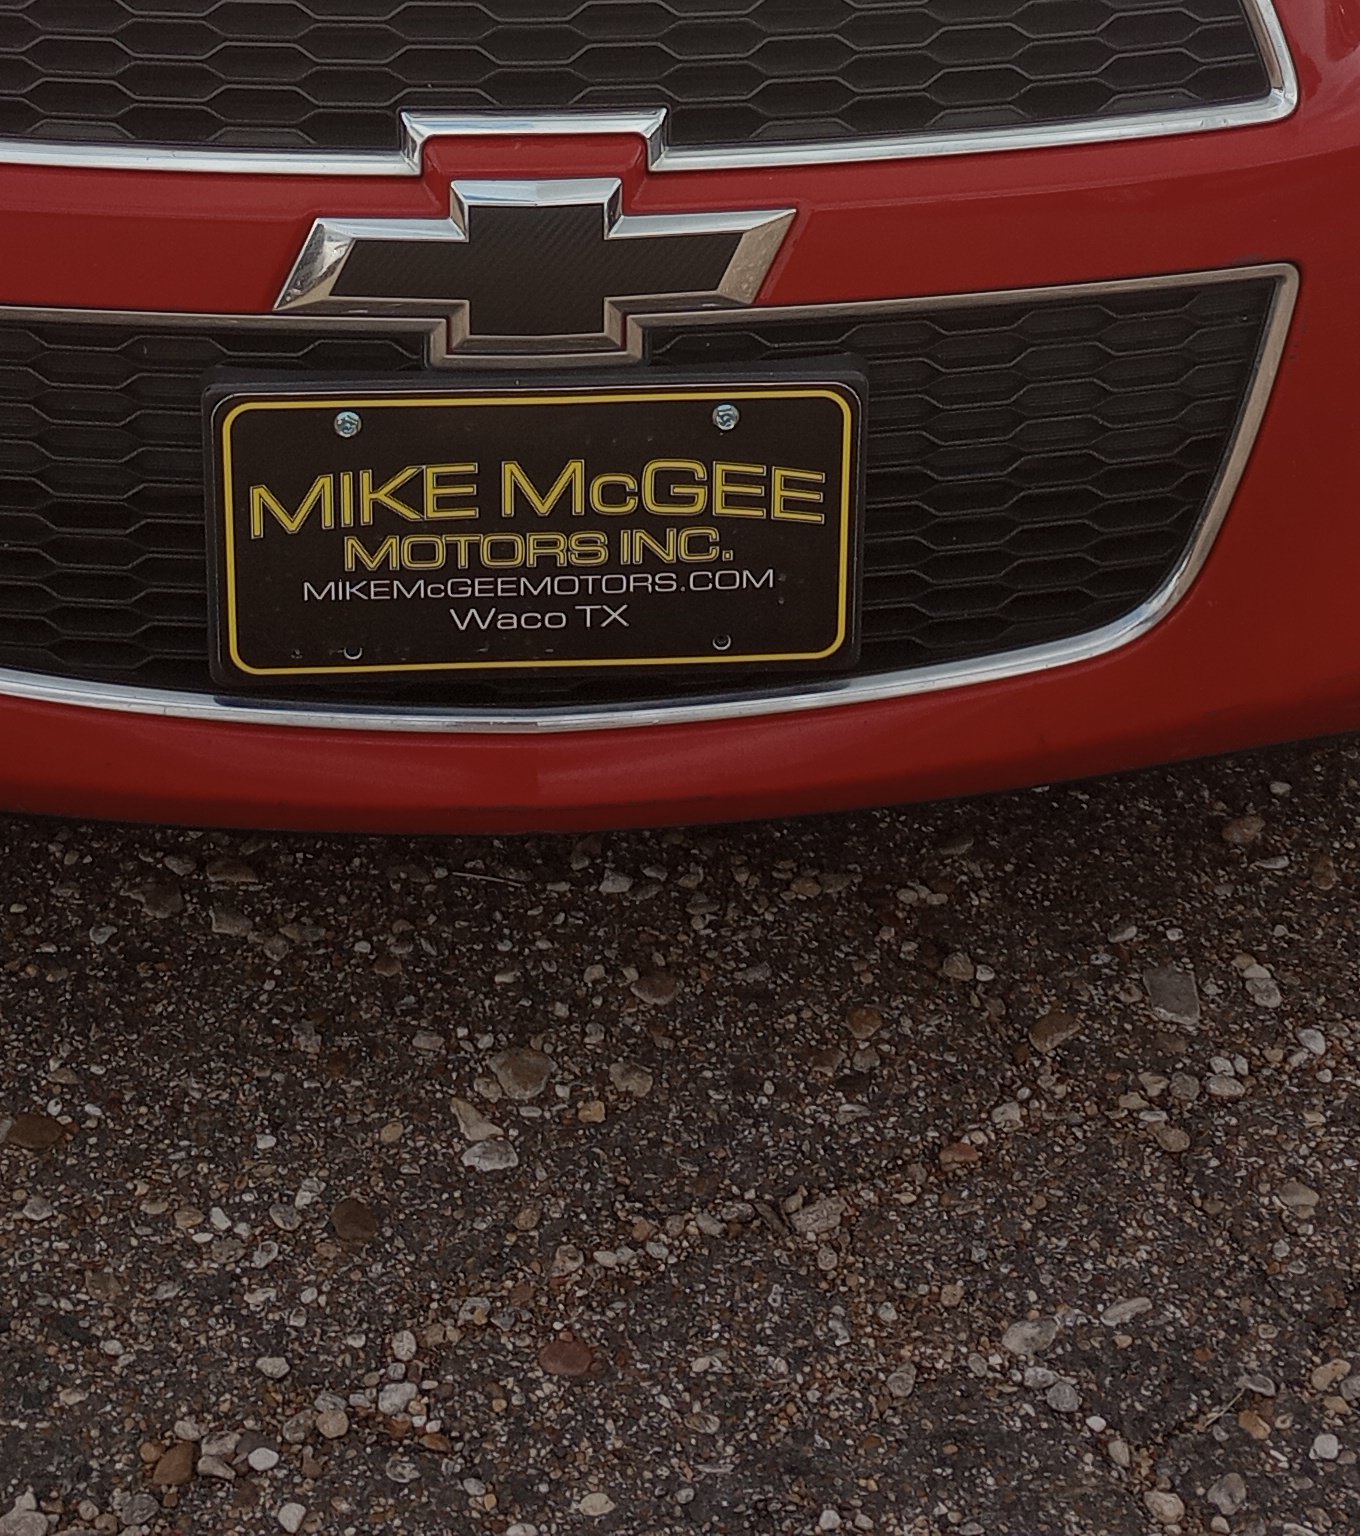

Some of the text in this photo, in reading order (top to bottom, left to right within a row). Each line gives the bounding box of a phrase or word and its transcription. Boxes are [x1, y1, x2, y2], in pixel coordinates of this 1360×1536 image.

[249, 459, 826, 539] MIKE McGEE
[344, 526, 735, 572] MOTORS INC.
[302, 569, 775, 602] MIKEMcGEEMOTORS.COM
[449, 604, 631, 632] Waco TX
